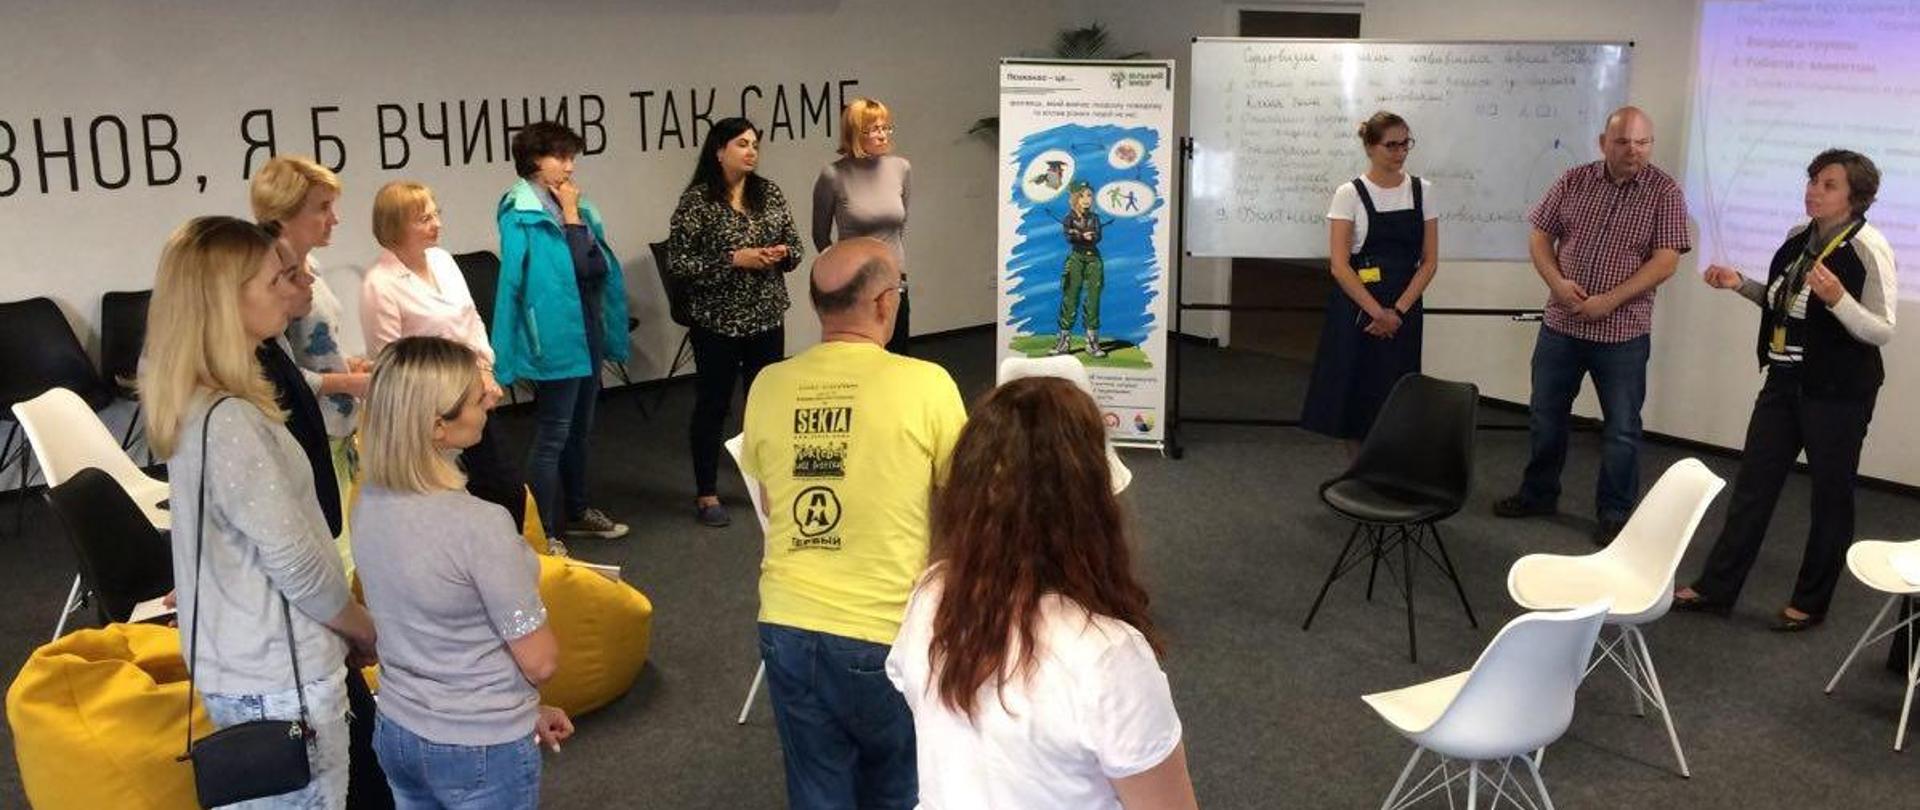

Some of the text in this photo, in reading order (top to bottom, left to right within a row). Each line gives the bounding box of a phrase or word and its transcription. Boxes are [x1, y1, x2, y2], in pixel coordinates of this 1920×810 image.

[241, 109, 276, 180] Я
[311, 106, 346, 174] Б
[630, 87, 716, 152] ТАК
[797, 407, 848, 433] SEKTA
